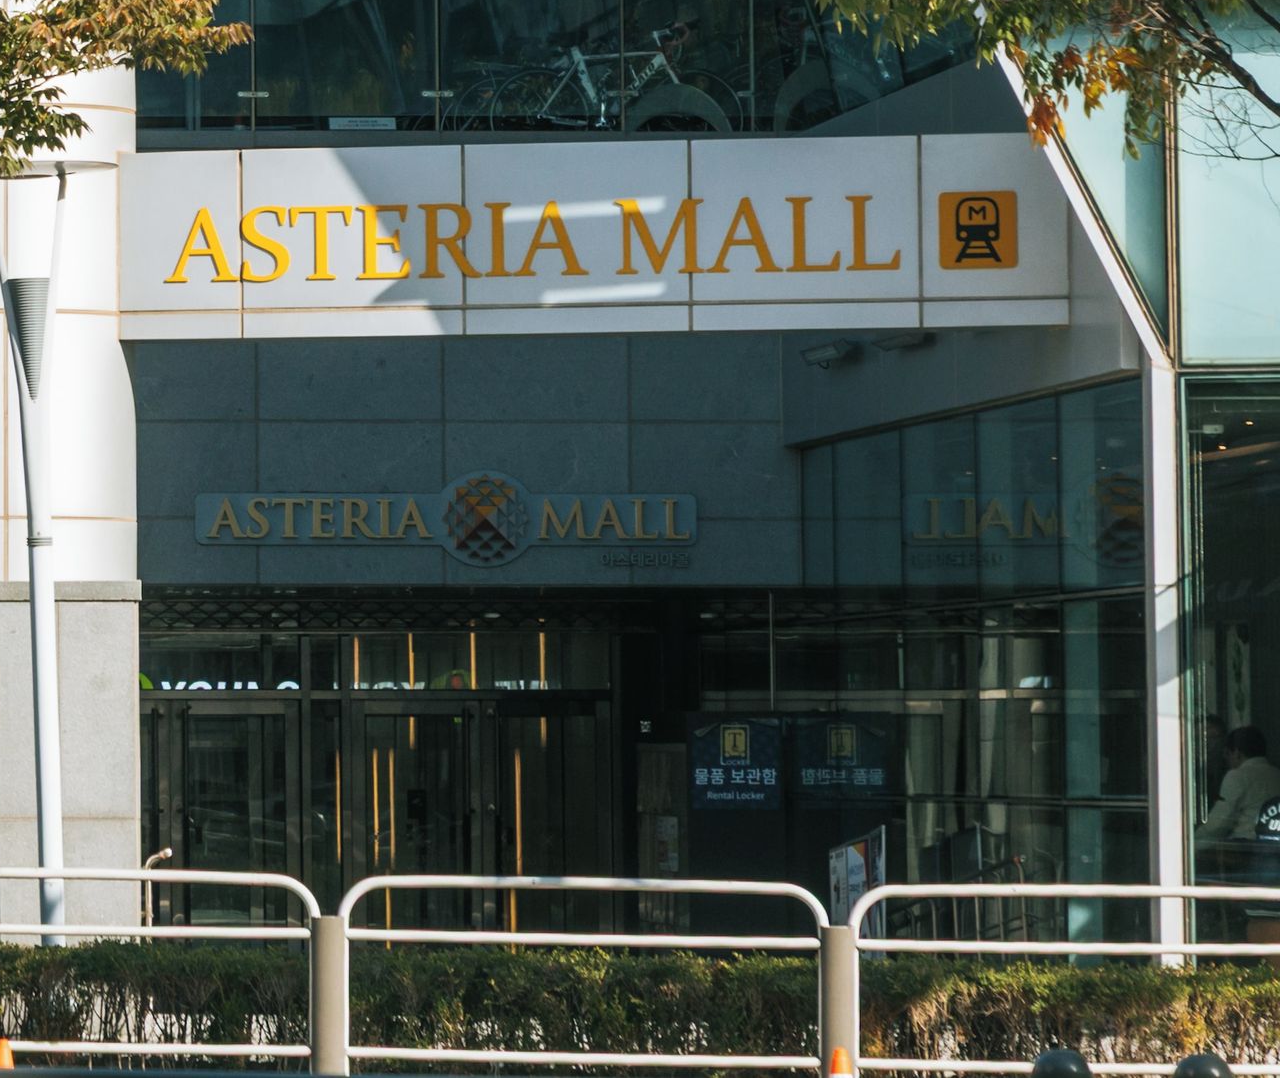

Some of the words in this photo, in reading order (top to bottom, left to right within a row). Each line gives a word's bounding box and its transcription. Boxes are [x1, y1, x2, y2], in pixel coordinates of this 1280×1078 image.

[164, 201, 589, 284] ASTERIA
[614, 194, 902, 275] MALL
[205, 496, 432, 542] ASTERIA
[538, 495, 692, 541] MALL
[694, 768, 725, 785] 물품
[730, 767, 777, 785] 보관함
[706, 791, 734, 800] Rental
[736, 791, 765, 800] Locker
